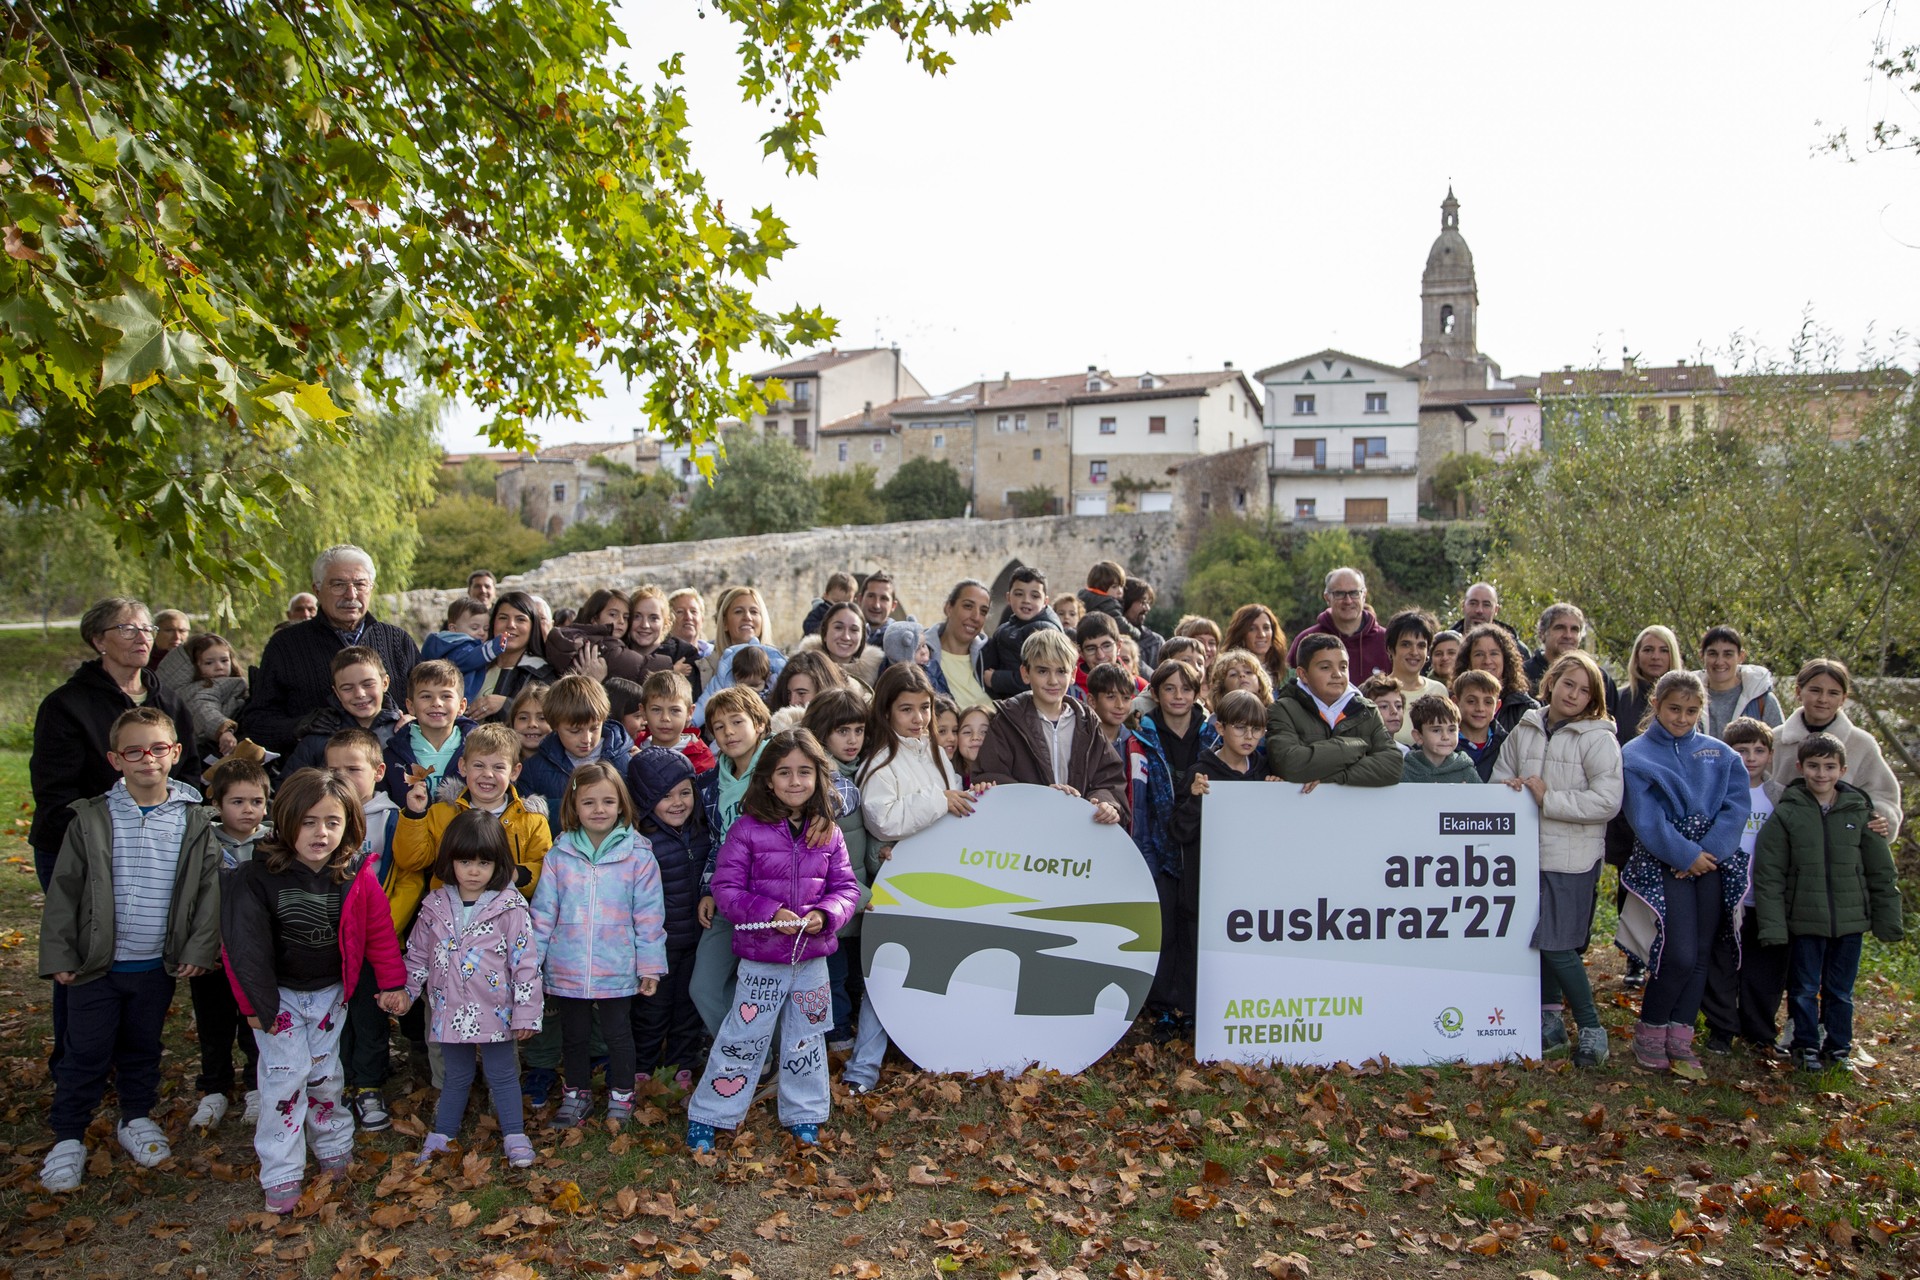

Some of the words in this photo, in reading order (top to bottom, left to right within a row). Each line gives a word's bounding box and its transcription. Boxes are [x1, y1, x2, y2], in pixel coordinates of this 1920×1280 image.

[1443, 817, 1493, 831] Ekainak
[1495, 817, 1510, 831] 13
[960, 847, 1021, 870] LOTUZ
[1023, 854, 1092, 879] LORTU!
[1384, 845, 1516, 888] araba
[744, 973, 782, 991] HAPPY
[750, 989, 787, 1003] EVERY
[759, 1002, 778, 1013] DAY
[1223, 996, 1363, 1019] ARGANTZUN
[1223, 1017, 1323, 1045] TREBIÑU
